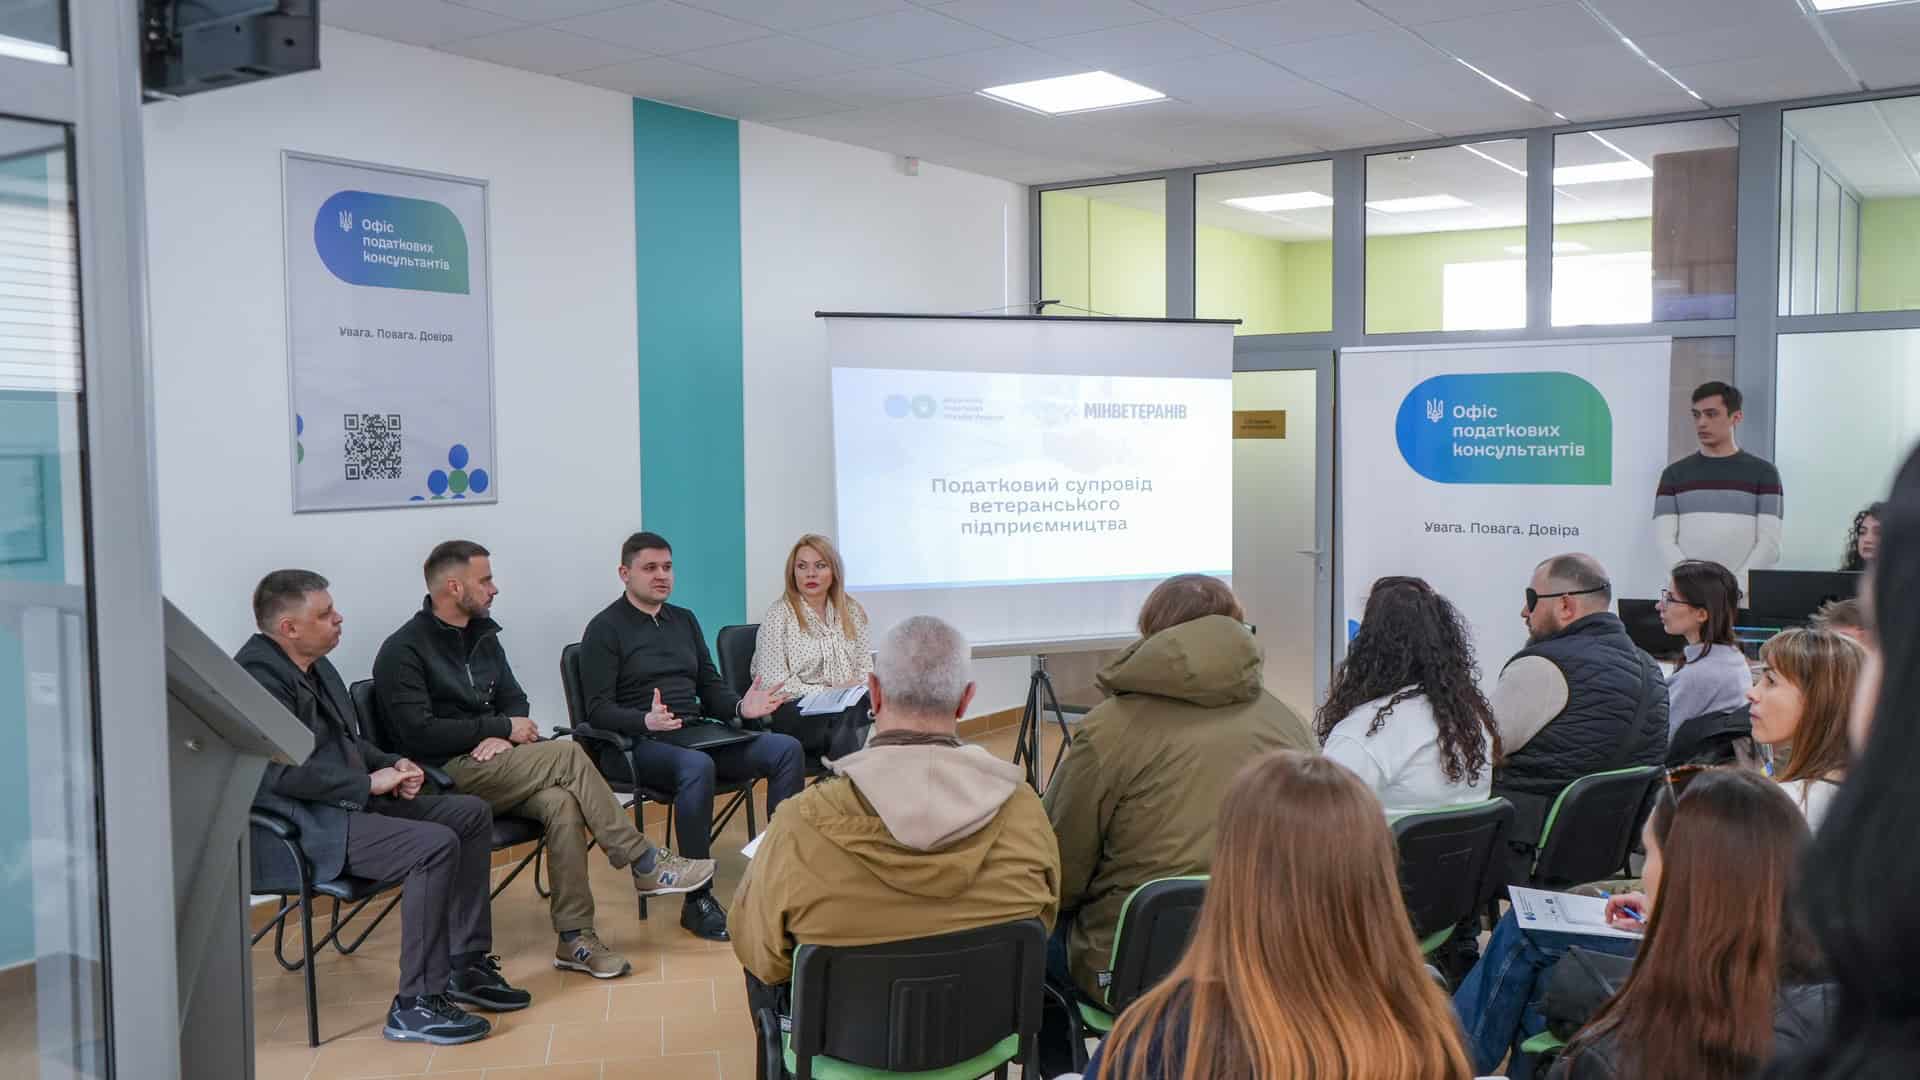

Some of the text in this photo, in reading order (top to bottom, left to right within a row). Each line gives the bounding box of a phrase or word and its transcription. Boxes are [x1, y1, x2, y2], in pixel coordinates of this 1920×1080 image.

[362, 218, 395, 234] Офіс
[362, 236, 434, 254] податкових
[363, 250, 451, 271] консультантів
[377, 328, 418, 340] Повага.
[420, 331, 454, 343] Довіра
[1083, 402, 1188, 420] МІНВЕТЕРАНІВ
[1452, 404, 1499, 421] Офіс
[1453, 423, 1561, 440] податкових
[1453, 442, 1585, 461] консультантів
[931, 476, 1154, 494] Податковий супровід
[969, 497, 1121, 516] ветеранського
[961, 518, 1128, 537] підприємництва
[1424, 521, 1581, 538] Увага. Повага. Довіра
